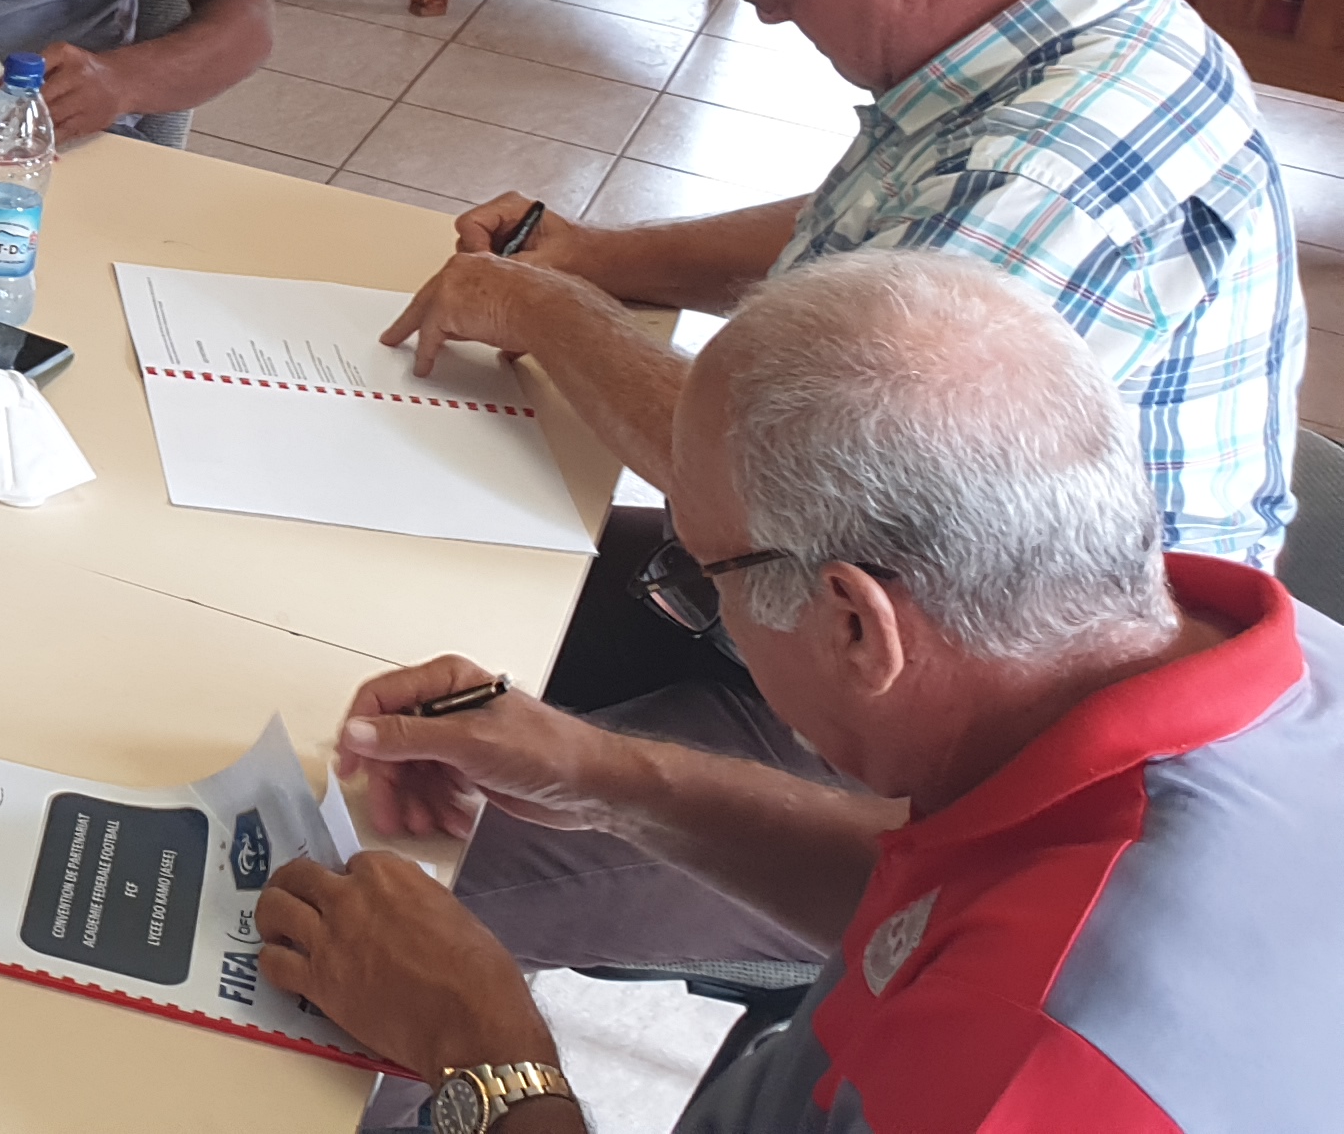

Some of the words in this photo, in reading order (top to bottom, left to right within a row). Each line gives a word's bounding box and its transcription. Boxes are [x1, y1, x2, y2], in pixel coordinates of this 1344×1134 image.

[65, 813, 90, 870] PARTENARIAT
[99, 819, 120, 861] FOOTBALL
[63, 870, 79, 883] DE
[159, 849, 177, 877] (ASEE)
[91, 861, 113, 902] FEDERALE
[124, 881, 139, 898] FCF
[153, 878, 171, 905] KAMO
[52, 882, 77, 938] CONVENTION
[151, 905, 166, 919] DO
[237, 910, 253, 935] OFC
[83, 903, 104, 948] ACADEMIE
[147, 920, 164, 946] LYCEE
[218, 951, 259, 1006] FIFA
